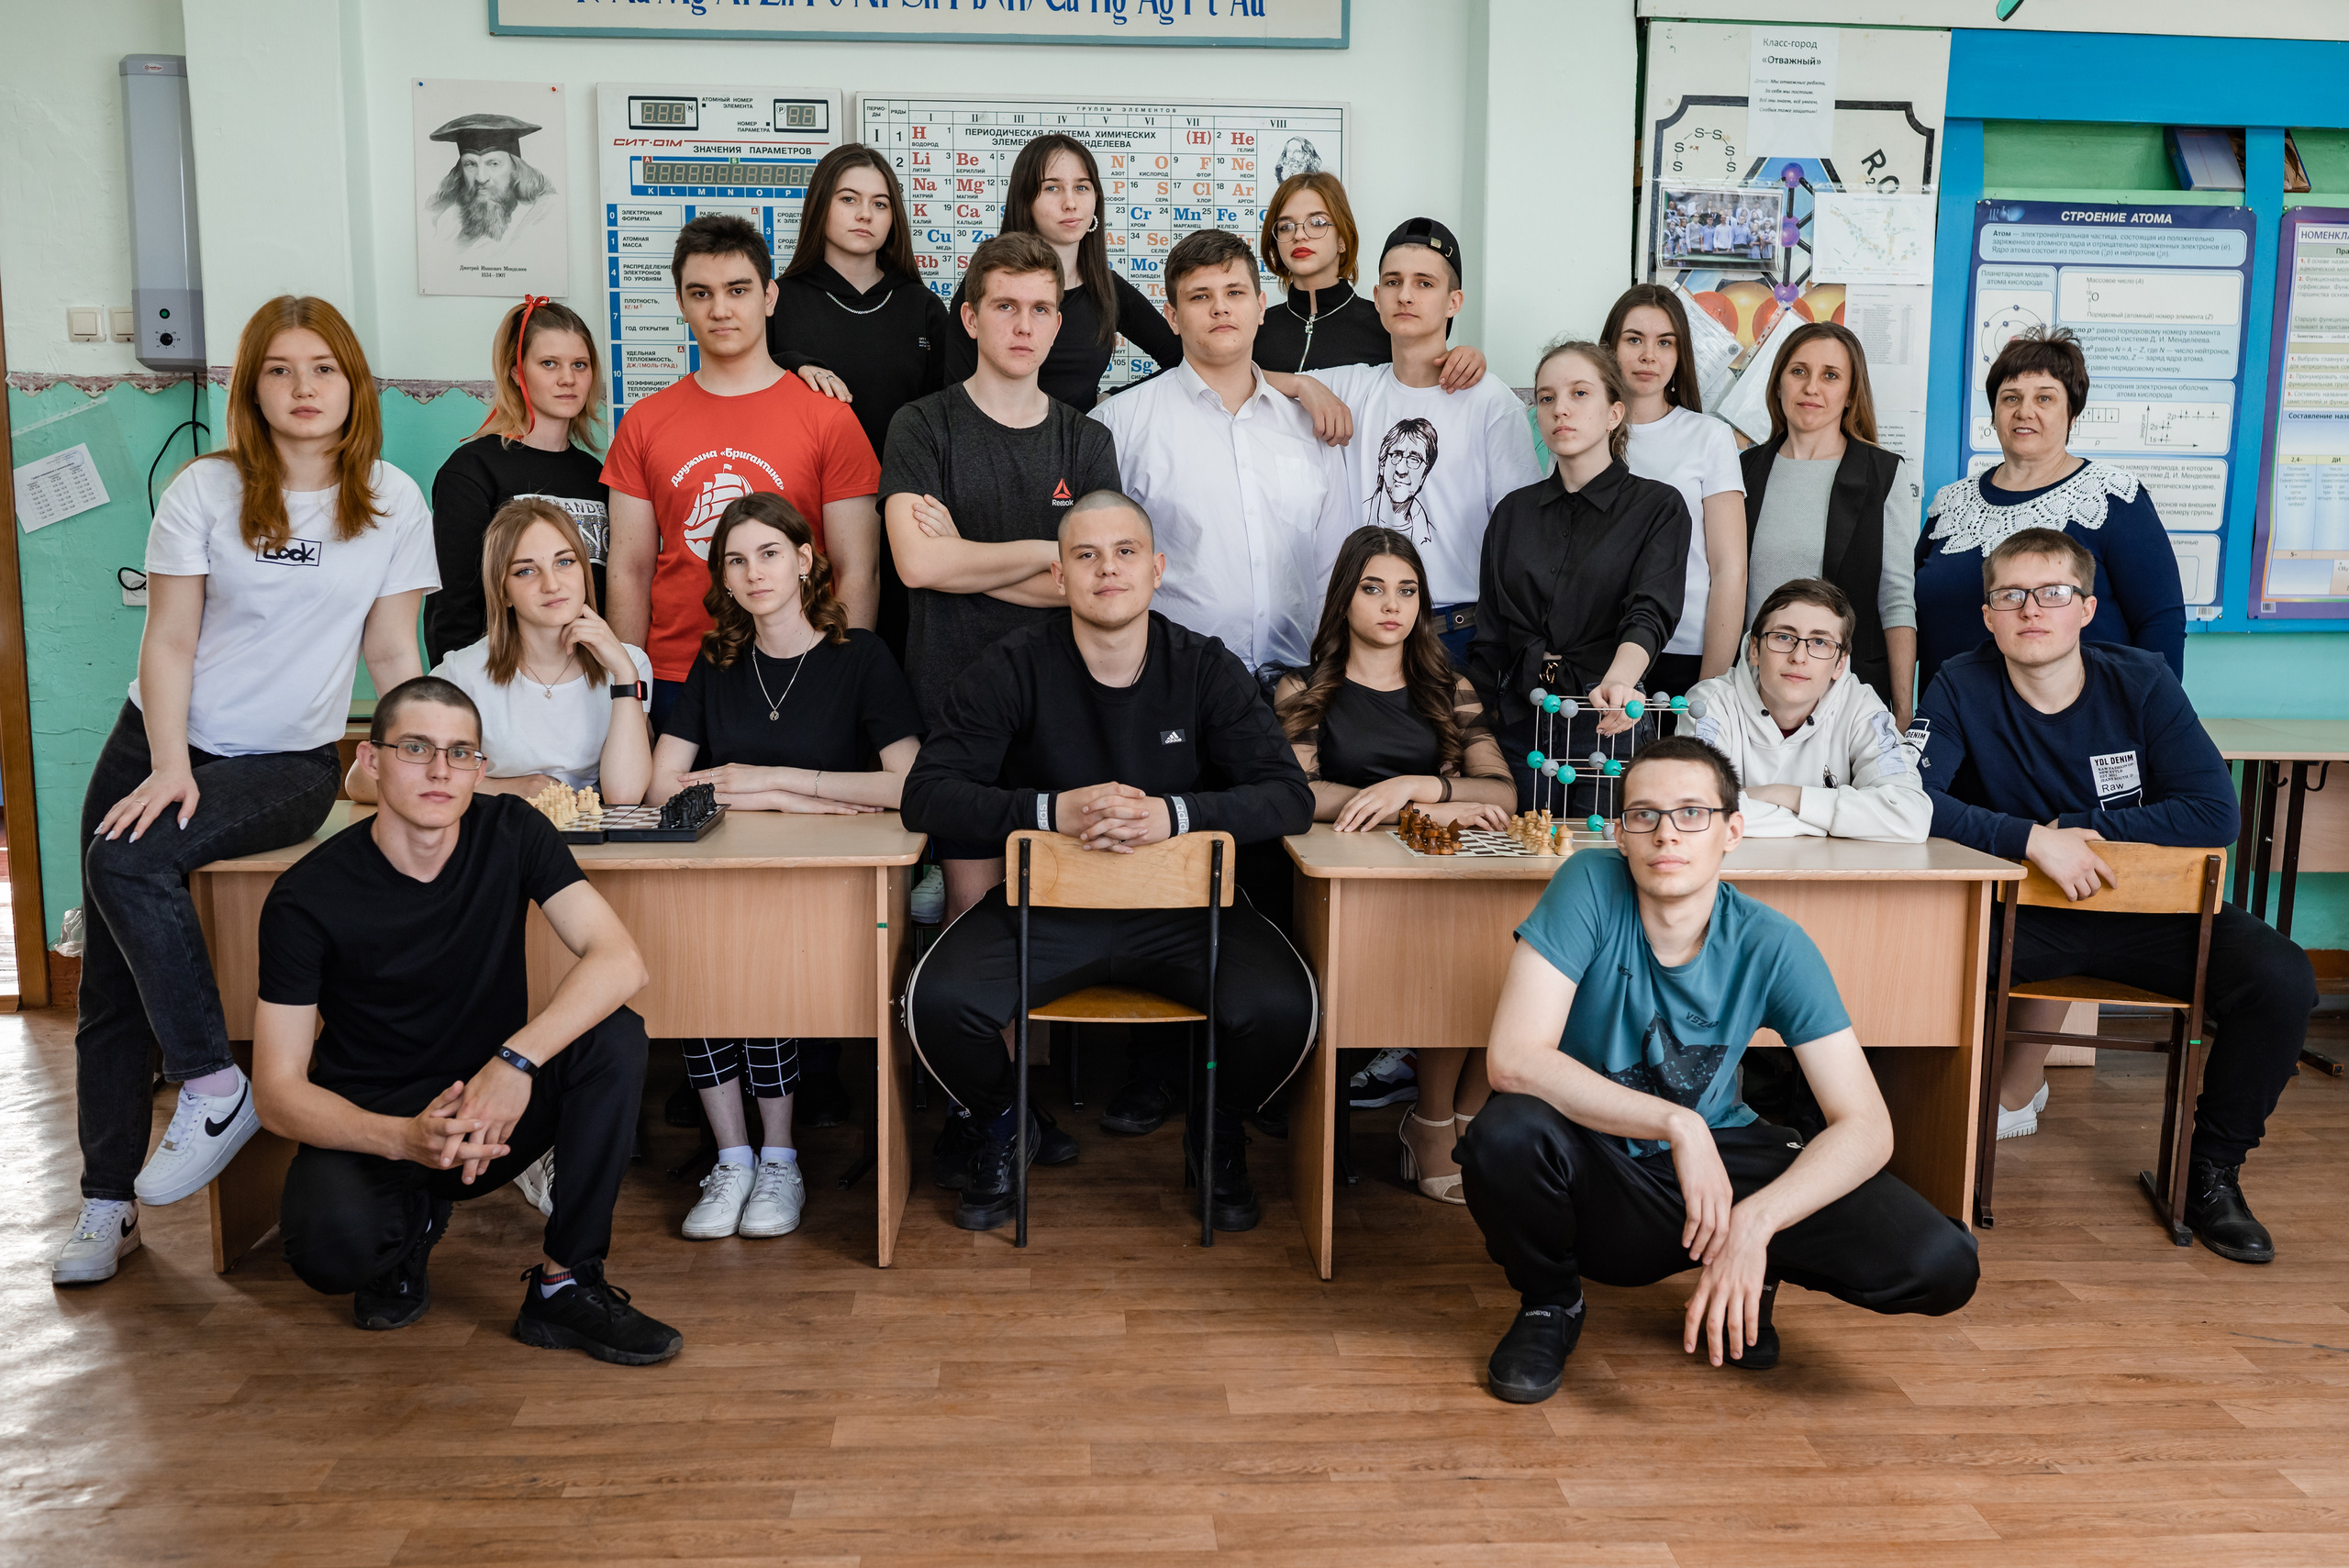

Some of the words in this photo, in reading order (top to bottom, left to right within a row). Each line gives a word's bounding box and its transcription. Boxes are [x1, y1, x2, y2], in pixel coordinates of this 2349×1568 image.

[1763, 39, 1818, 50] Класс-город
[1762, 56, 1821, 65] «Отважный»
[912, 127, 927, 139] H
[965, 128, 1043, 137] ПЕРИОДИЧЕСКАЯ
[1096, 130, 1156, 139] ХИМИЧЕСКИХ
[1230, 132, 1254, 146] He
[693, 146, 741, 154] ЗНАЧЕНИЯ
[750, 147, 812, 155] ПАРАМЕТРОВ
[912, 152, 931, 165] Li
[956, 153, 979, 166] Be
[1111, 155, 1125, 169] N
[1200, 157, 1211, 170] F
[1231, 158, 1254, 171] Ne
[912, 178, 937, 191] Na
[956, 179, 985, 194] Mg
[1232, 183, 1254, 196] Ar
[957, 205, 980, 217] Ca
[1130, 207, 1152, 220] Cr
[1174, 207, 1202, 221] Mn
[1216, 208, 1237, 221] Fe
[2061, 211, 2126, 223] СТРОЕНИЕ
[2131, 213, 2173, 224] АТОМА
[927, 229, 952, 242] Cu
[1147, 232, 1169, 245] Se
[2121, 234, 2156, 242] состоящая
[2092, 241, 2138, 250] отрицательно
[1130, 258, 1158, 271] Mo
[1981, 270, 2022, 278] Планетарная
[2118, 328, 2159, 337] порядковому
[1130, 360, 1153, 373] Sg
[2110, 754, 2133, 764] DENIM
[2101, 784, 2123, 793] Raw
